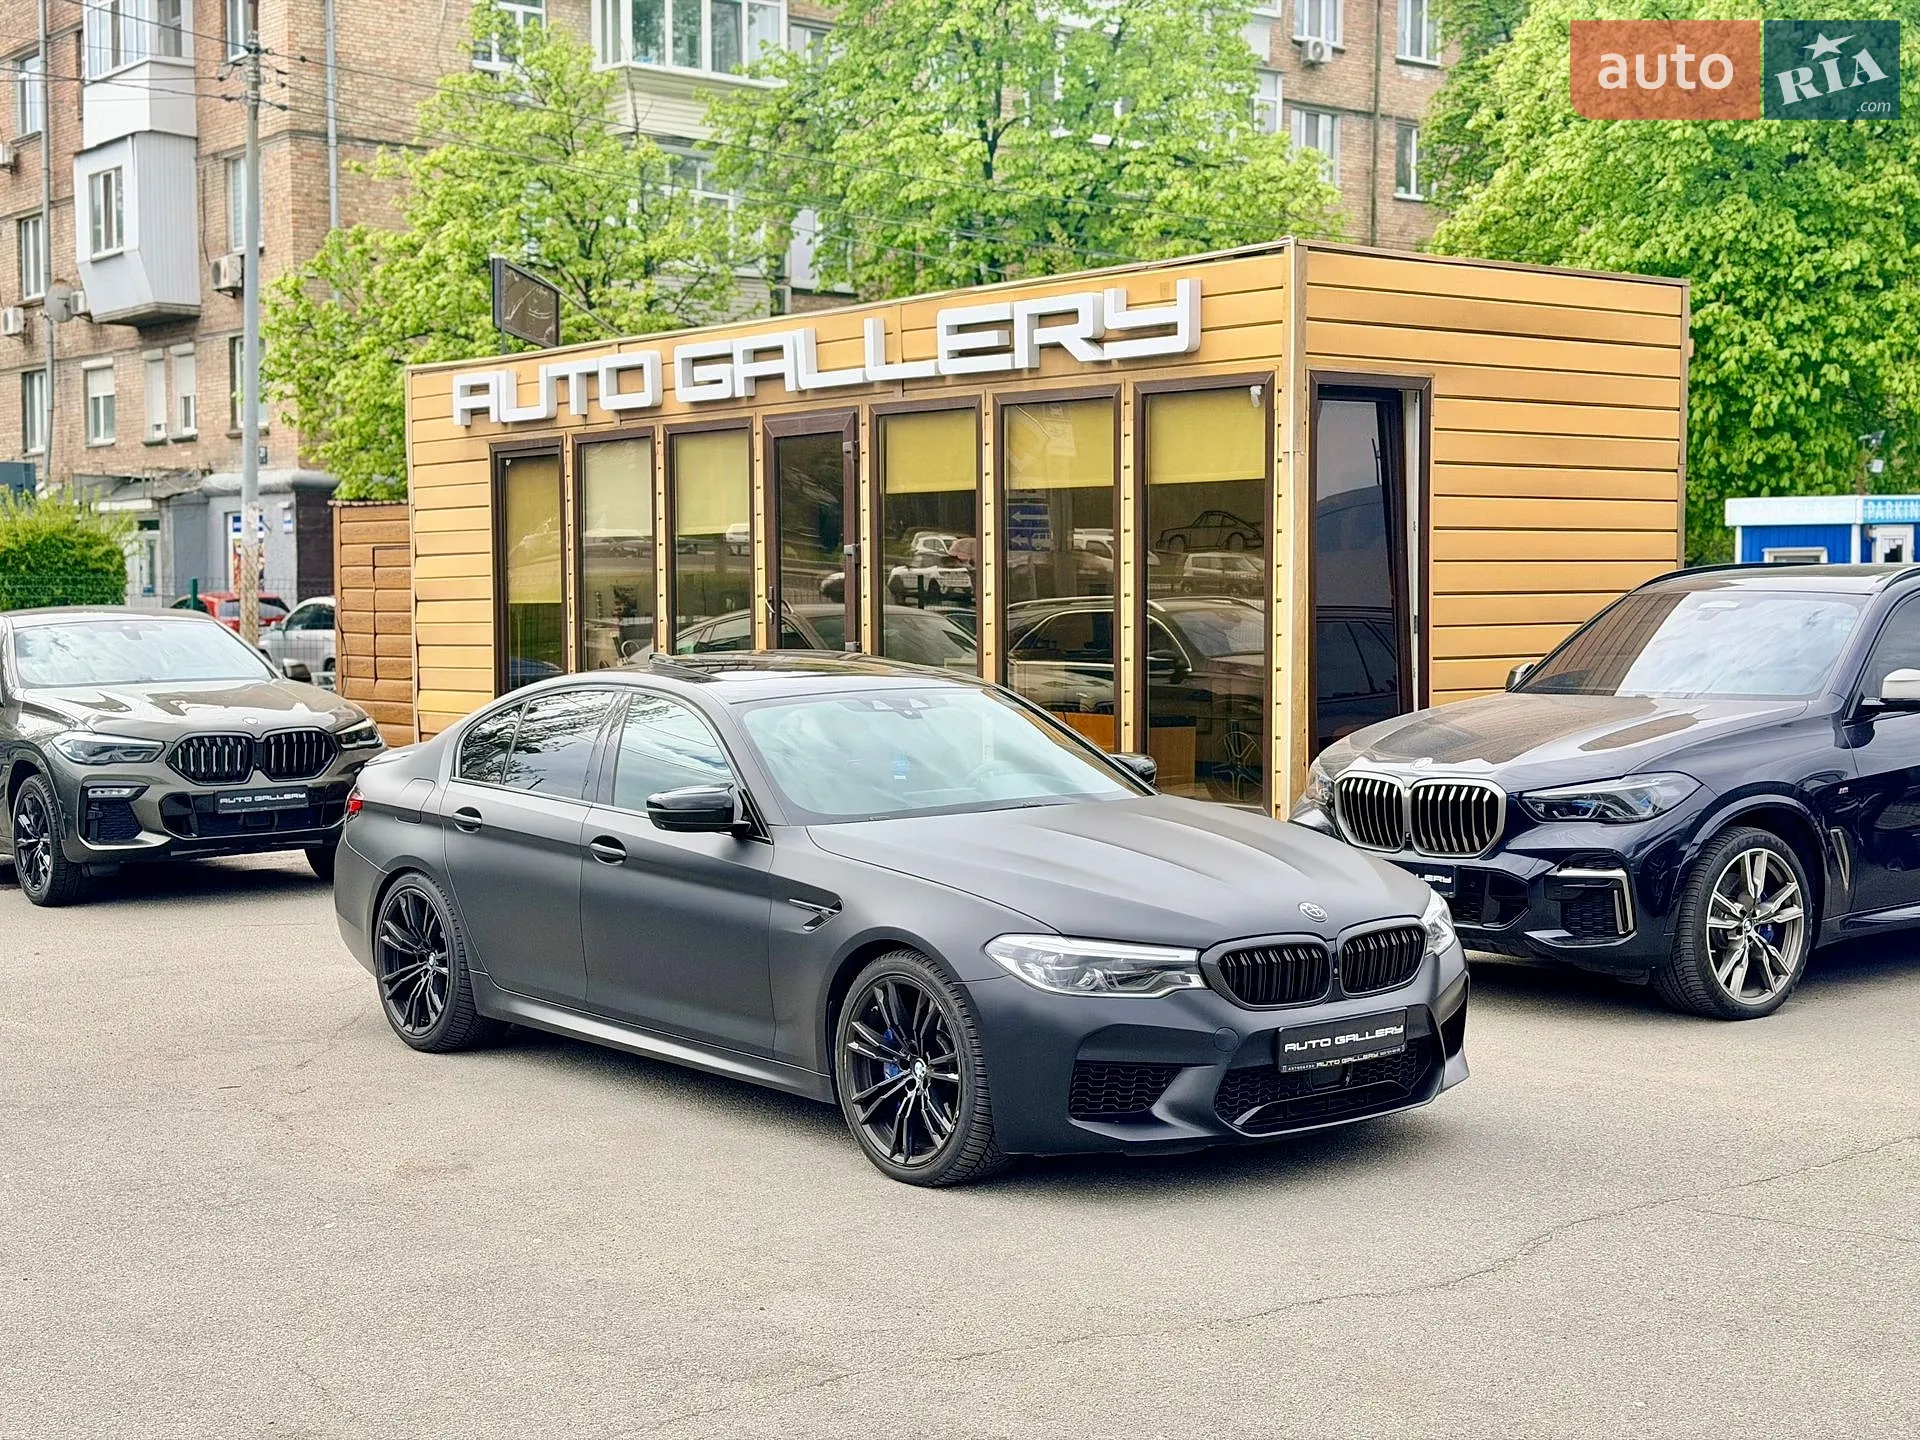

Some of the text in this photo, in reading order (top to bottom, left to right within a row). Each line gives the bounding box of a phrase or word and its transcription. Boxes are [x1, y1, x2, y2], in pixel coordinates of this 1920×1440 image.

[452, 278, 1201, 426] AUTO GALLERY
[220, 792, 306, 804] AUTO GALLERY
[1284, 1024, 1404, 1052] AUTO GALLERY
[1316, 1059, 1340, 1068] AUTO
[1341, 1052, 1379, 1064] GALLERY
